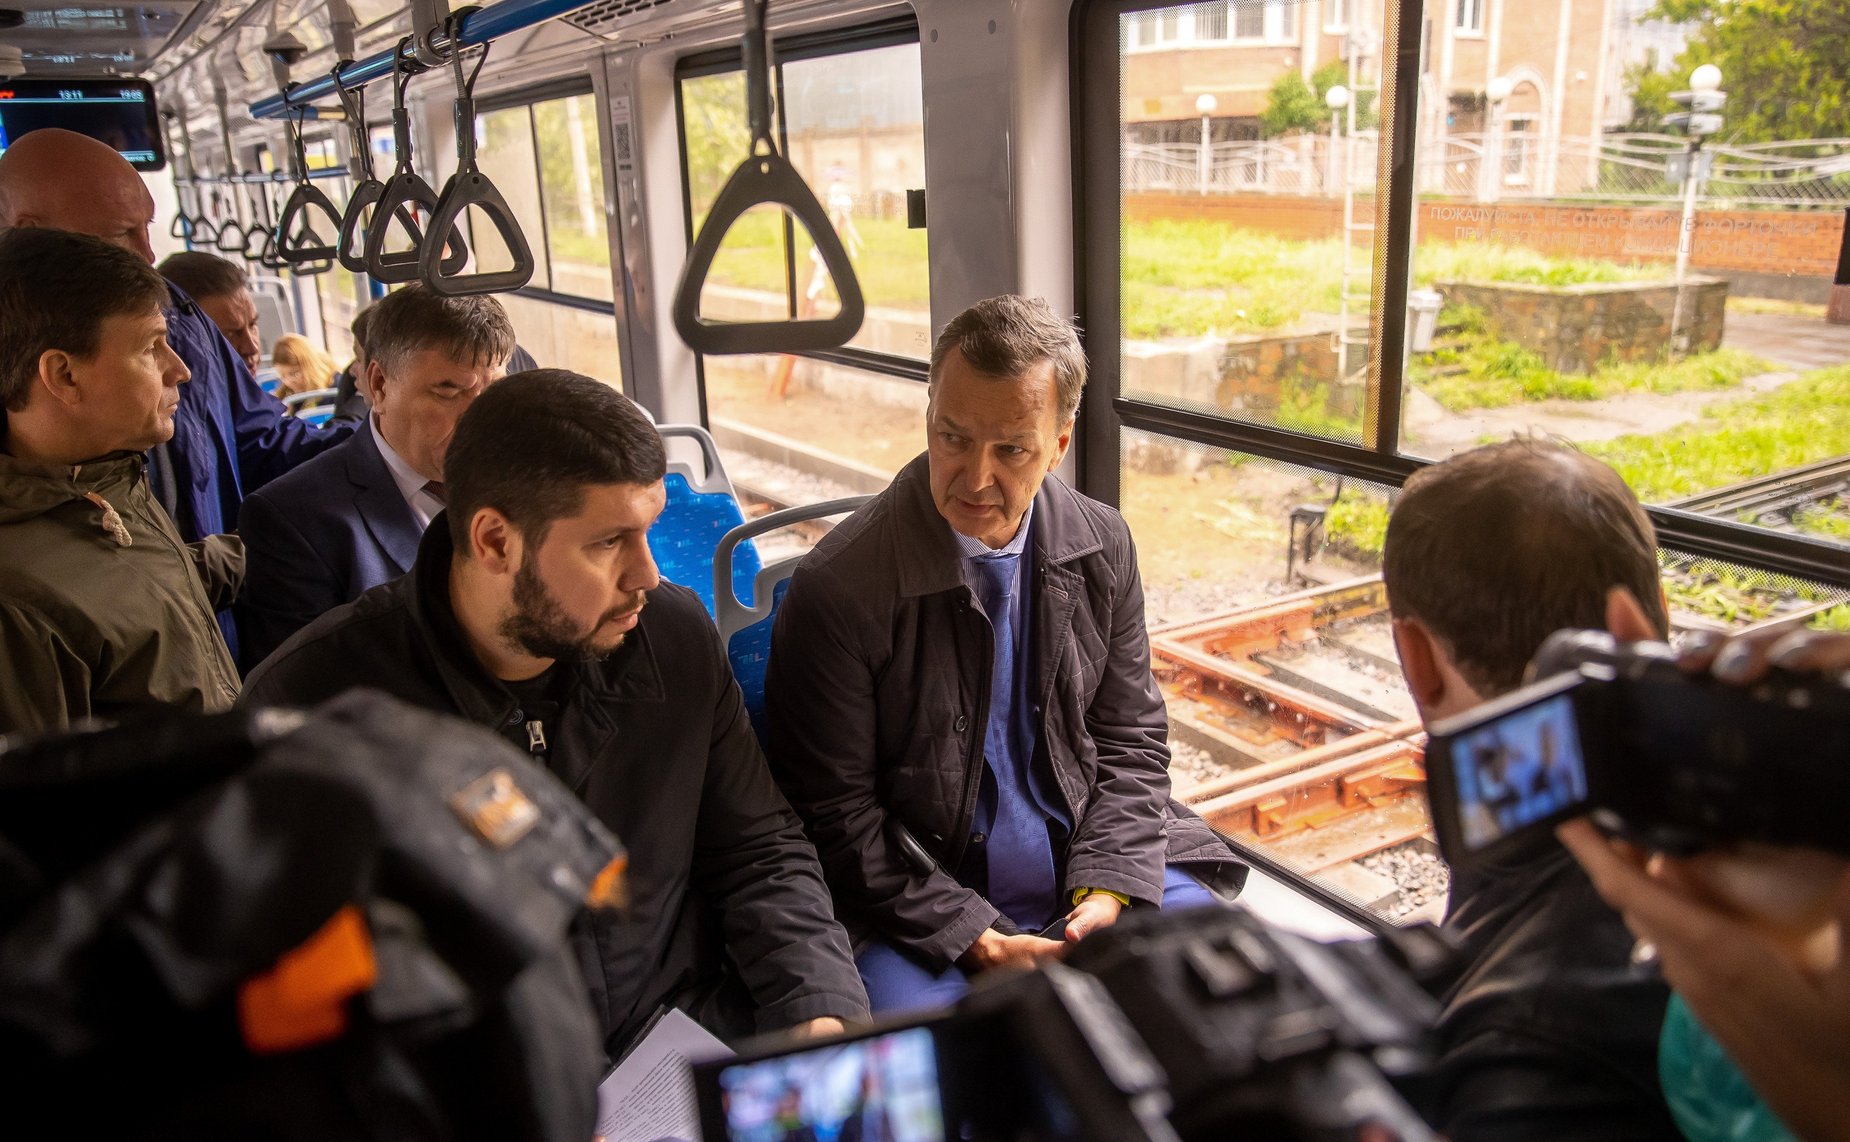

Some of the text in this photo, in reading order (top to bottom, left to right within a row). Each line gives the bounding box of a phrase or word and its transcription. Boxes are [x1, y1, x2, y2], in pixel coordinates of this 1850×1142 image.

[1454, 226, 1485, 241] ПРИ
[1544, 211, 1568, 227] НЕ
[1703, 217, 1818, 238] ФОРТОЧКИ
